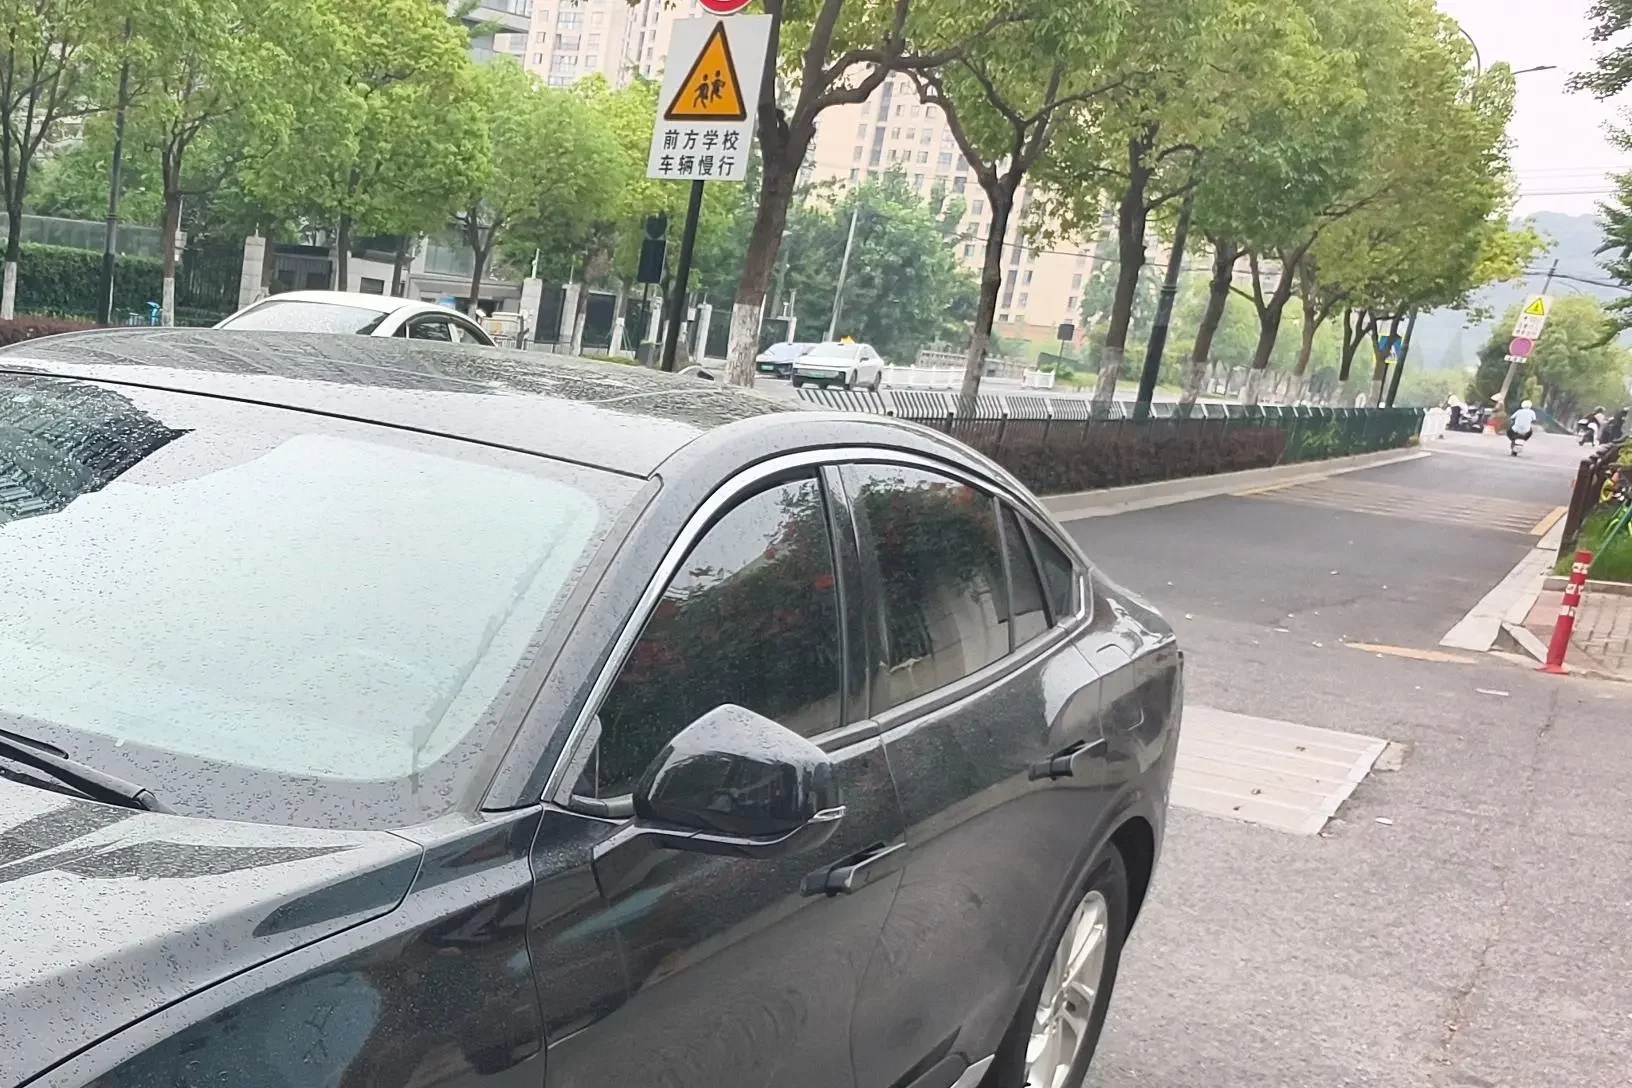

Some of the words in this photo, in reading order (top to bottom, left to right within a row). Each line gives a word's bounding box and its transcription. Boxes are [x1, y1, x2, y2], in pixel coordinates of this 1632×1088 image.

[663, 129, 740, 151] 前方学校
[658, 155, 736, 176] 车辆慢行
